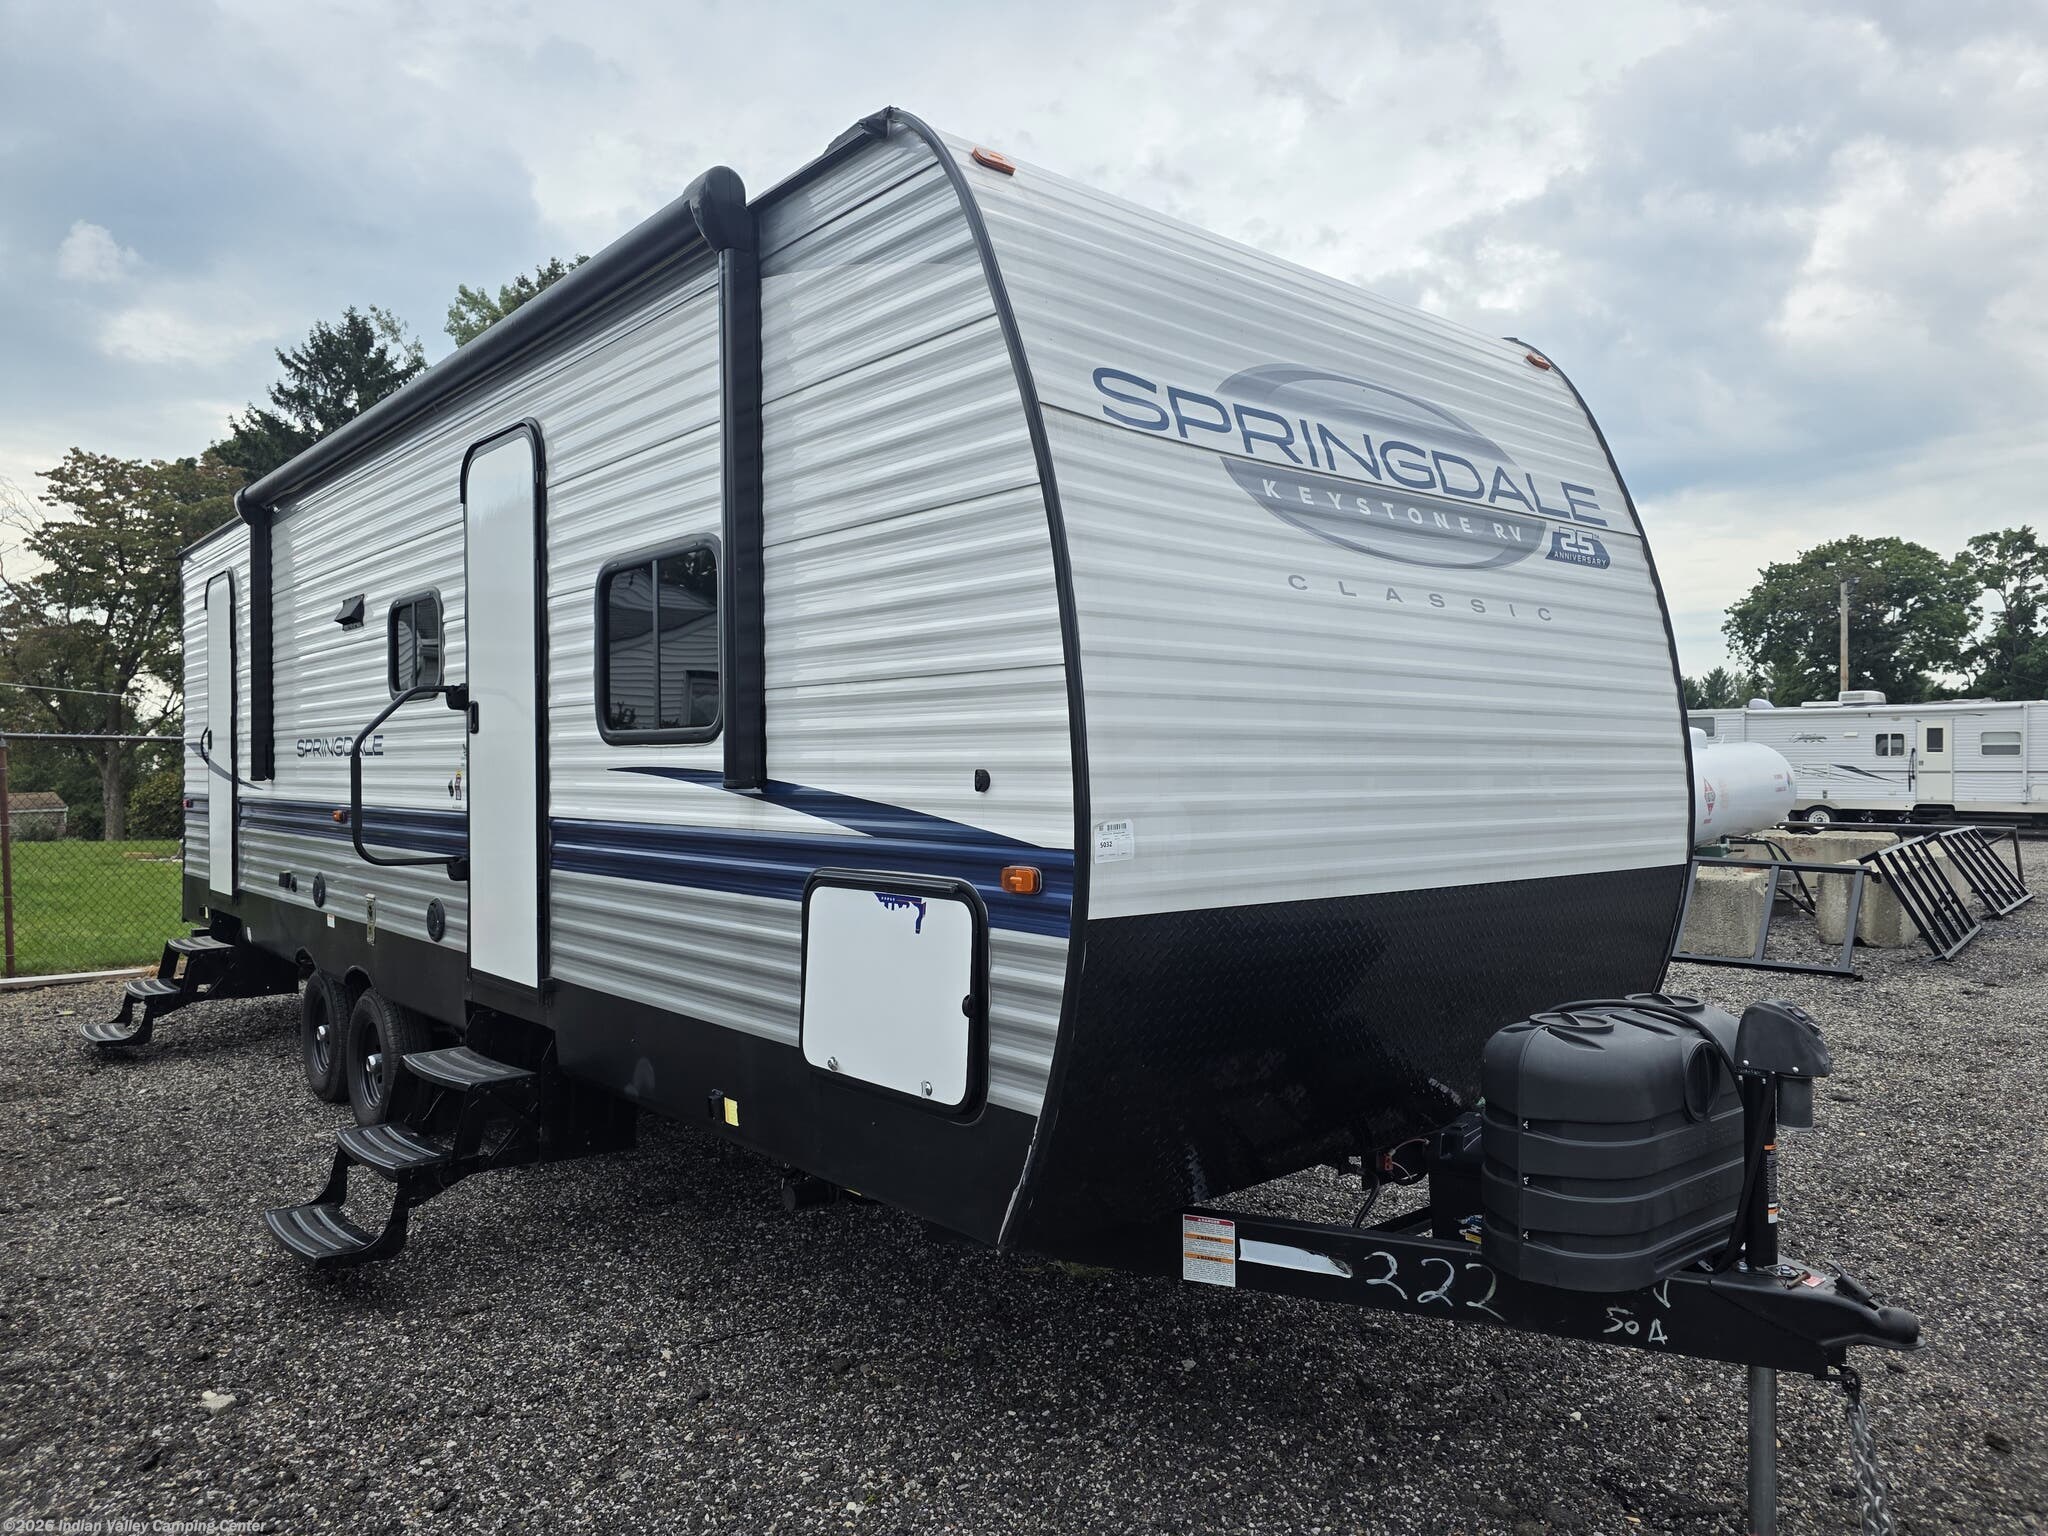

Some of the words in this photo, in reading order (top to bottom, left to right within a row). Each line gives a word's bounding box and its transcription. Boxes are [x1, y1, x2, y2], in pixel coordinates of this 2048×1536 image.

[1092, 367, 1609, 527] SPRINGDALE
[1262, 478, 1473, 535] KEYSTONE
[1492, 521, 1523, 544] RV
[1554, 551, 1607, 567] ANNIVERSARY
[1559, 527, 1595, 556] 25
[1288, 574, 1553, 622] CLASSIC
[297, 735, 384, 757] SPRINGDLE
[1363, 1251, 1505, 1321] 222
